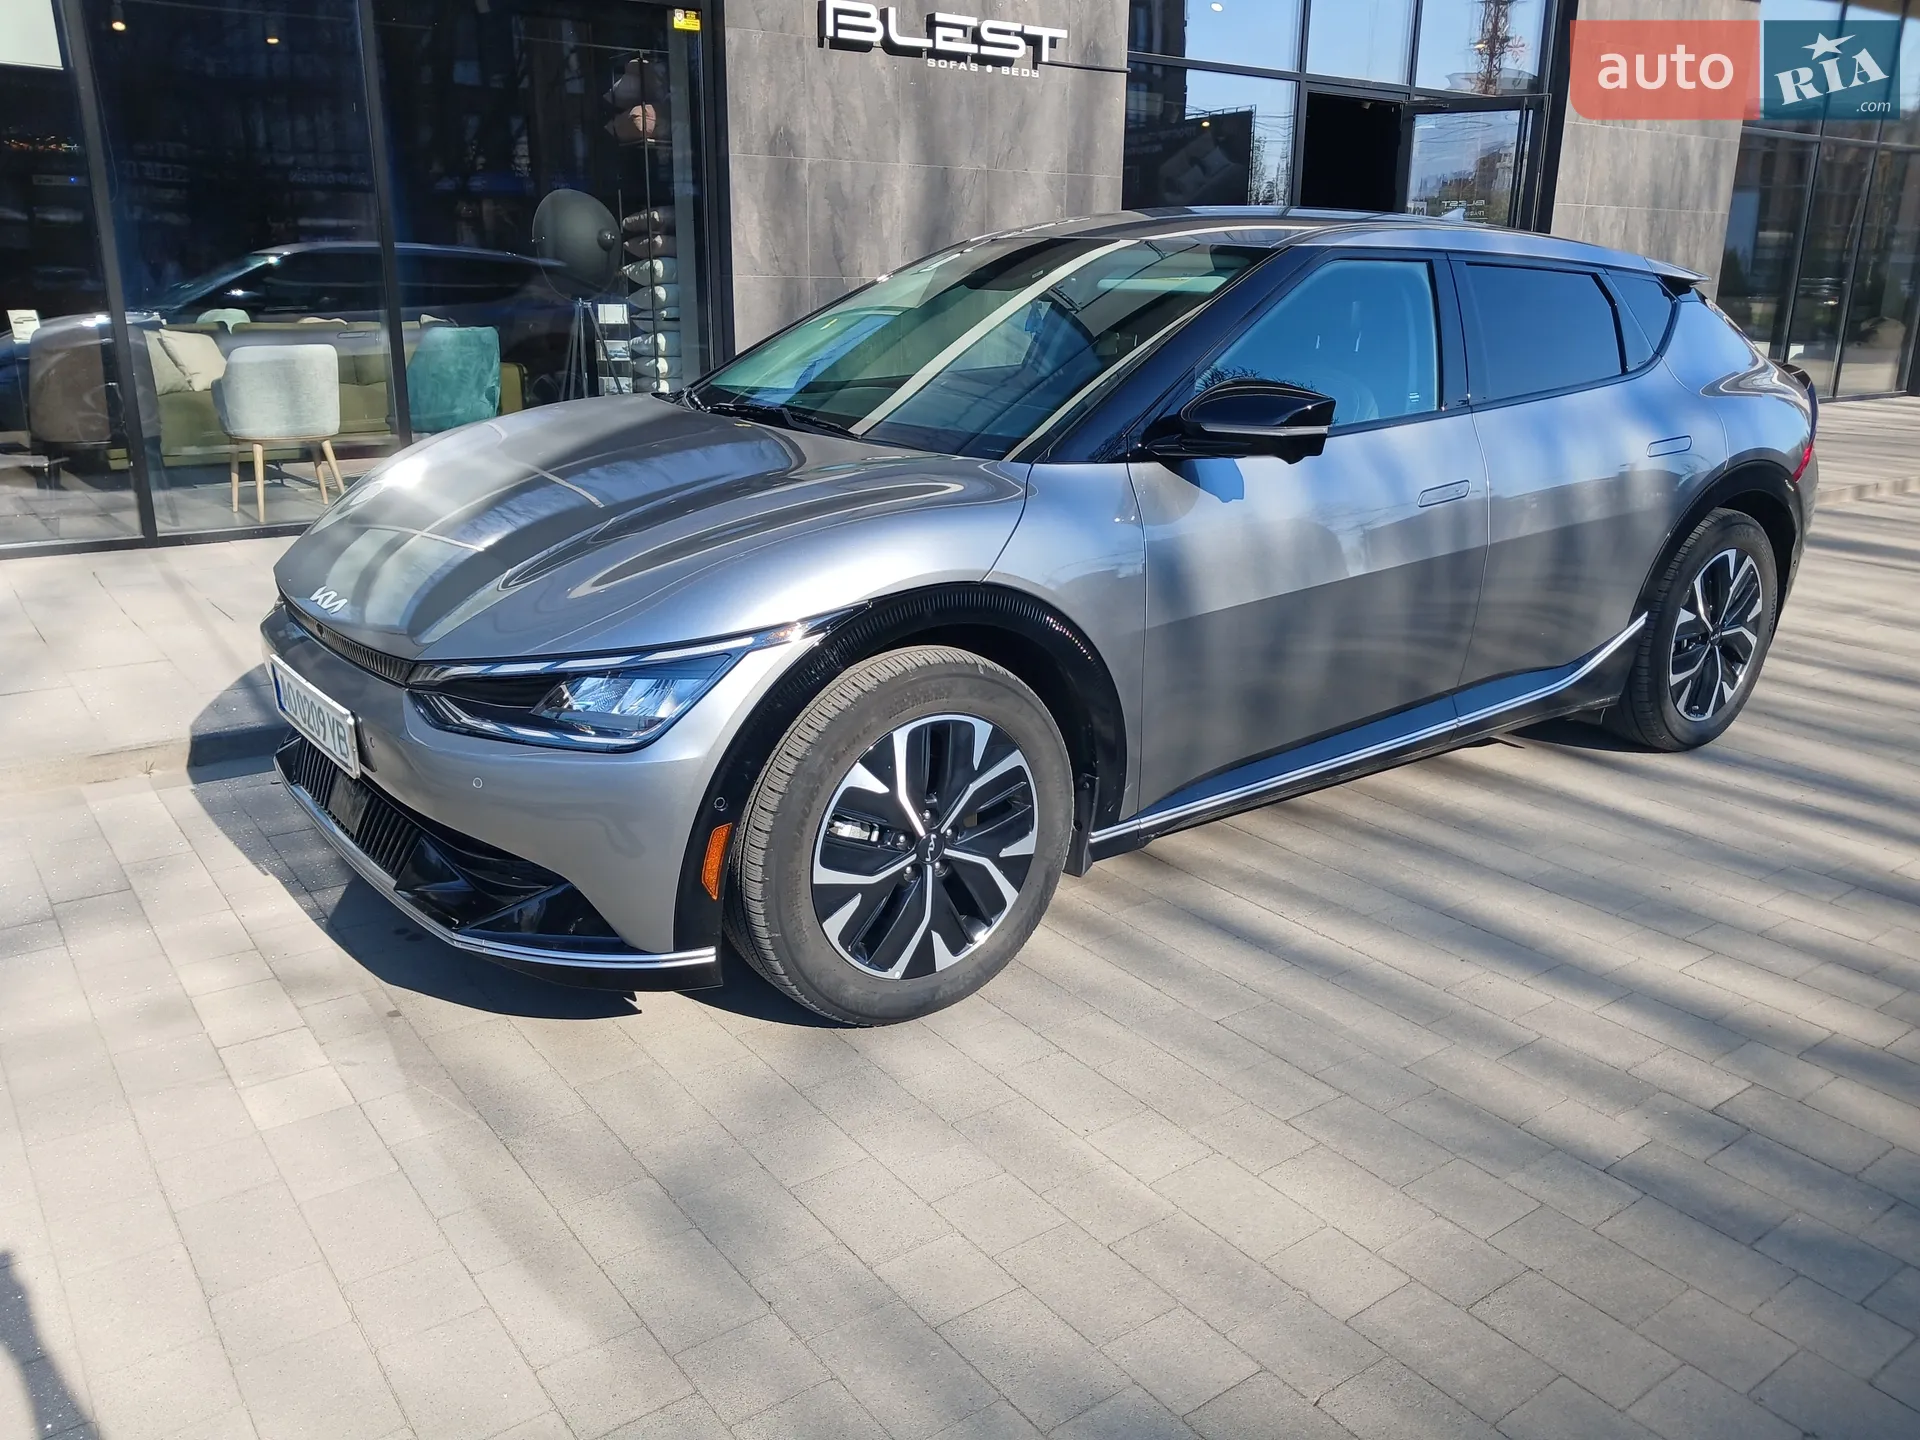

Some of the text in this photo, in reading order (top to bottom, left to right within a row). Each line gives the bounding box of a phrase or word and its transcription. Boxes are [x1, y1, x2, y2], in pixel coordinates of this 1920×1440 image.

[825, 0, 1068, 62] BLEST
[927, 58, 1040, 78] SOFAS BEDS
